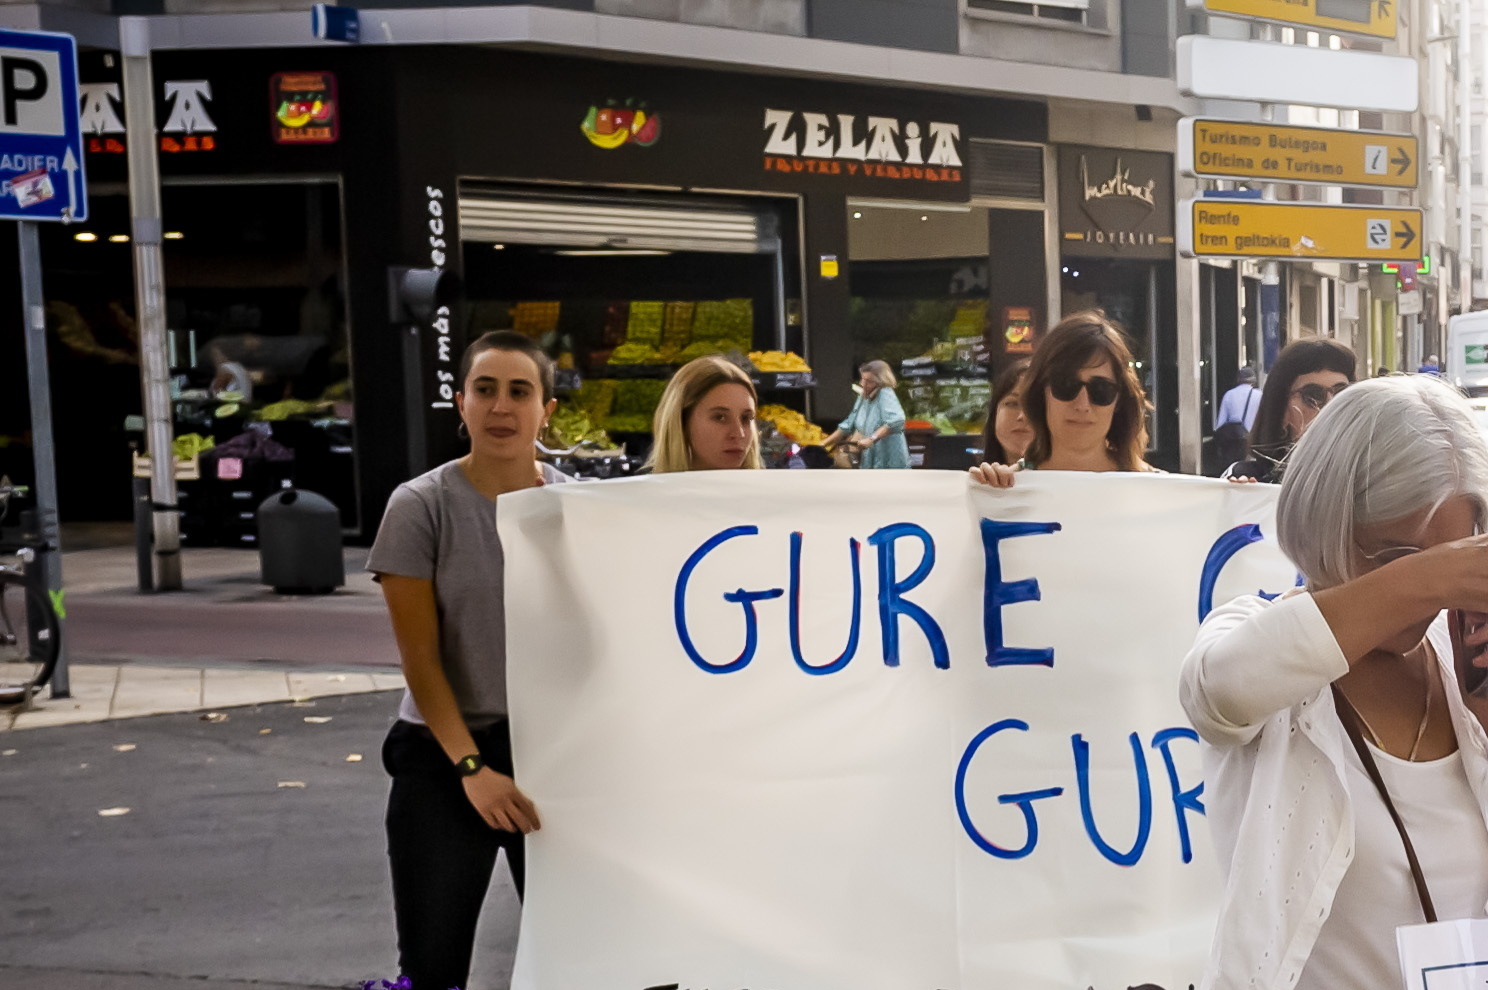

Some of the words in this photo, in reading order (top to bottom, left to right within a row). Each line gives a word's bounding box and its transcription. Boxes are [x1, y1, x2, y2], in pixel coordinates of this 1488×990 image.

[1, 55, 48, 126] P
[1200, 129, 1261, 146] Turismo
[1200, 151, 1254, 169] Oficina
[1261, 157, 1279, 170] de
[1286, 157, 1343, 175] Turismo
[1199, 210, 1240, 226] Renfe
[1200, 232, 1228, 246] tren
[1235, 234, 1290, 250] geltokia
[431, 369, 454, 408] los
[674, 517, 1062, 676] GURE
[955, 718, 1206, 867] GUR
